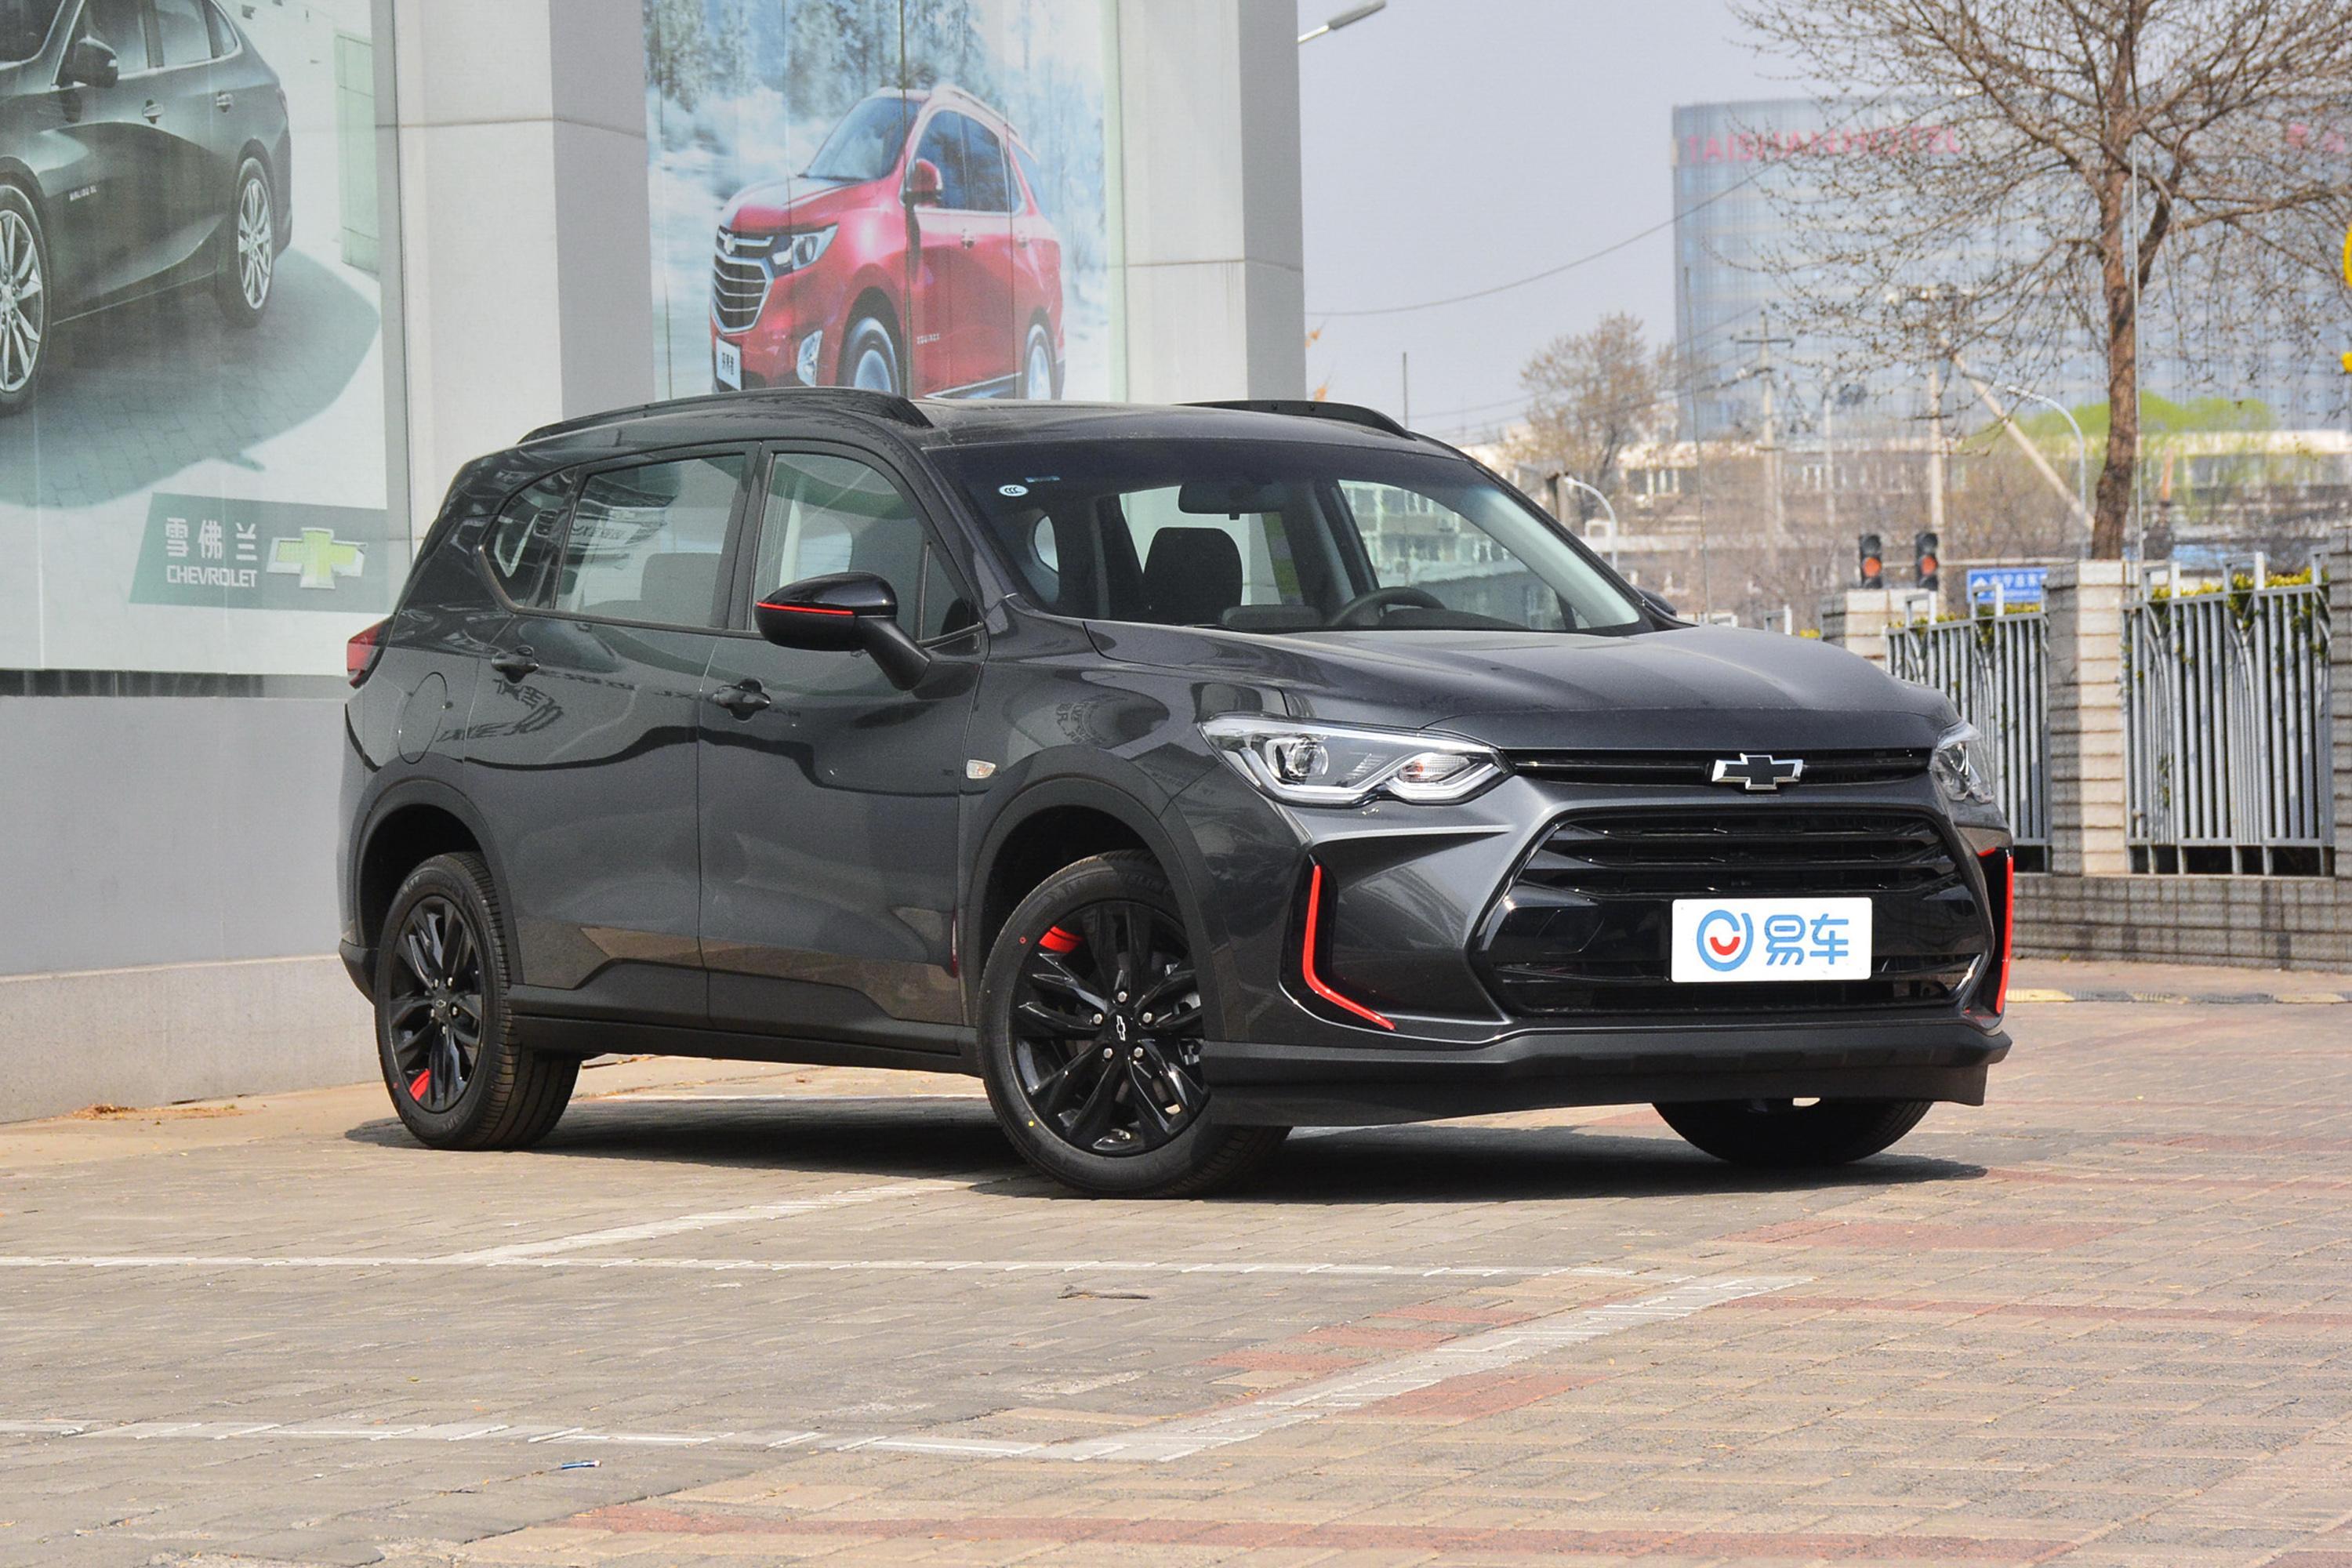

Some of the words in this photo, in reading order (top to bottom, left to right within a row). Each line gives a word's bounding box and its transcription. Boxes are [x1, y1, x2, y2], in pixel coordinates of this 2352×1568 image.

[165, 517, 258, 561] 雪佛兰
[166, 564, 258, 588] CHEVROLET
[1764, 913, 1849, 966] 易车
